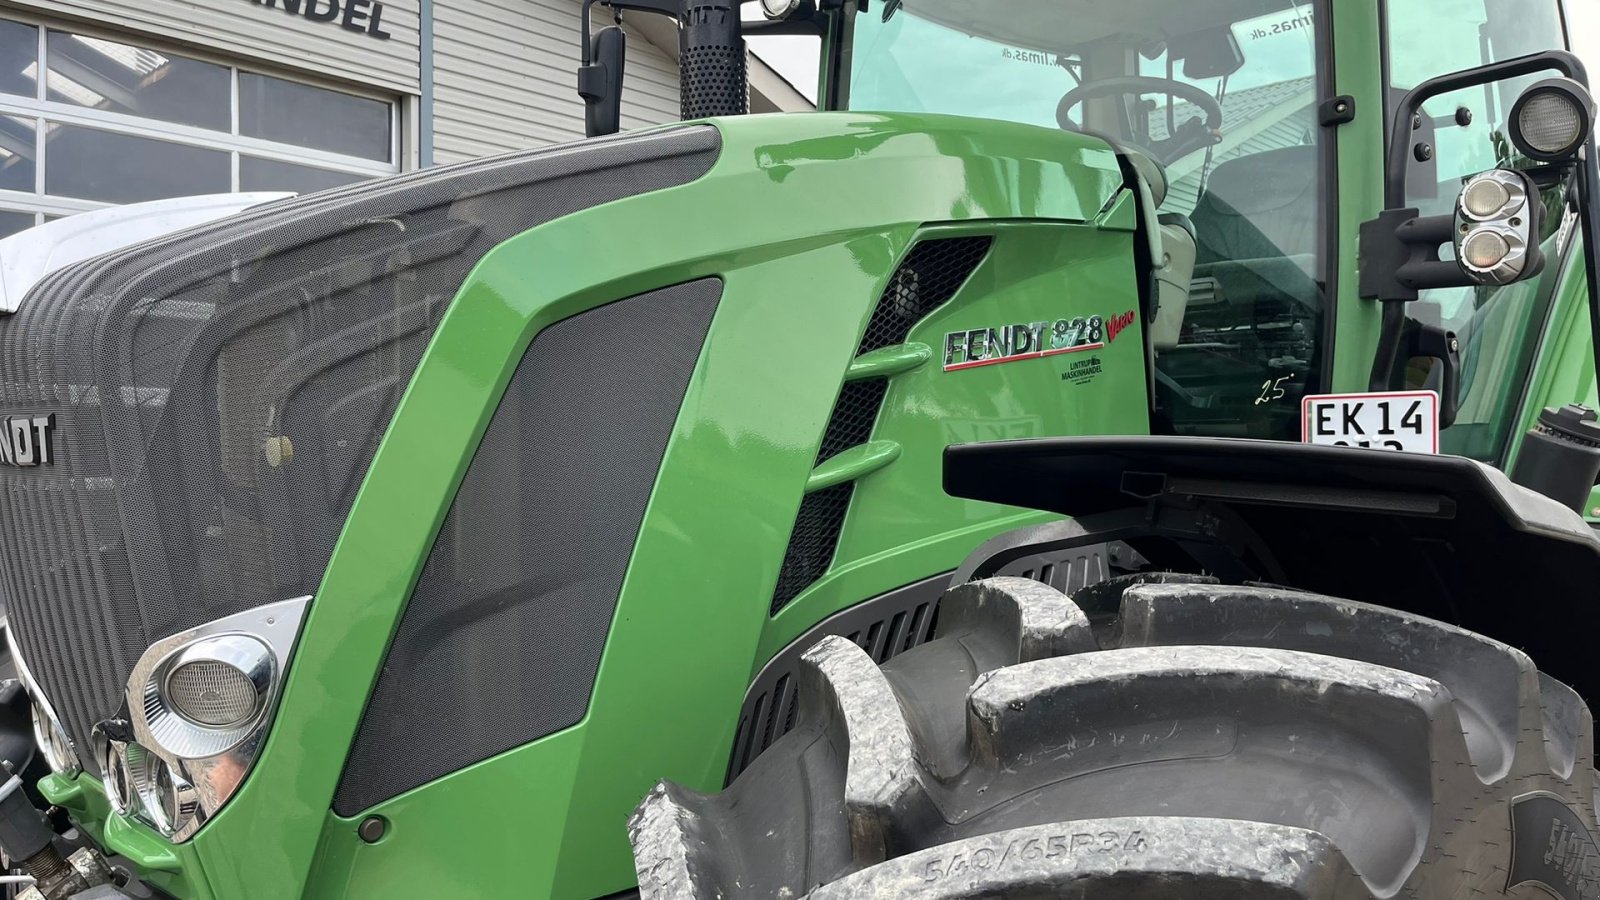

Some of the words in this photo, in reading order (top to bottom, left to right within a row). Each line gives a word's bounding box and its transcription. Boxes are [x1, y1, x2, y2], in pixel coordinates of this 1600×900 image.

[250, 0, 391, 40] DEL
[944, 321, 1049, 366] FENDT
[1052, 315, 1103, 349] 828
[1061, 364, 1102, 380] MASKINHANDEL
[1316, 403, 1365, 435] EK
[1378, 400, 1422, 434] 14
[923, 830, 1148, 884] 540/65R34
